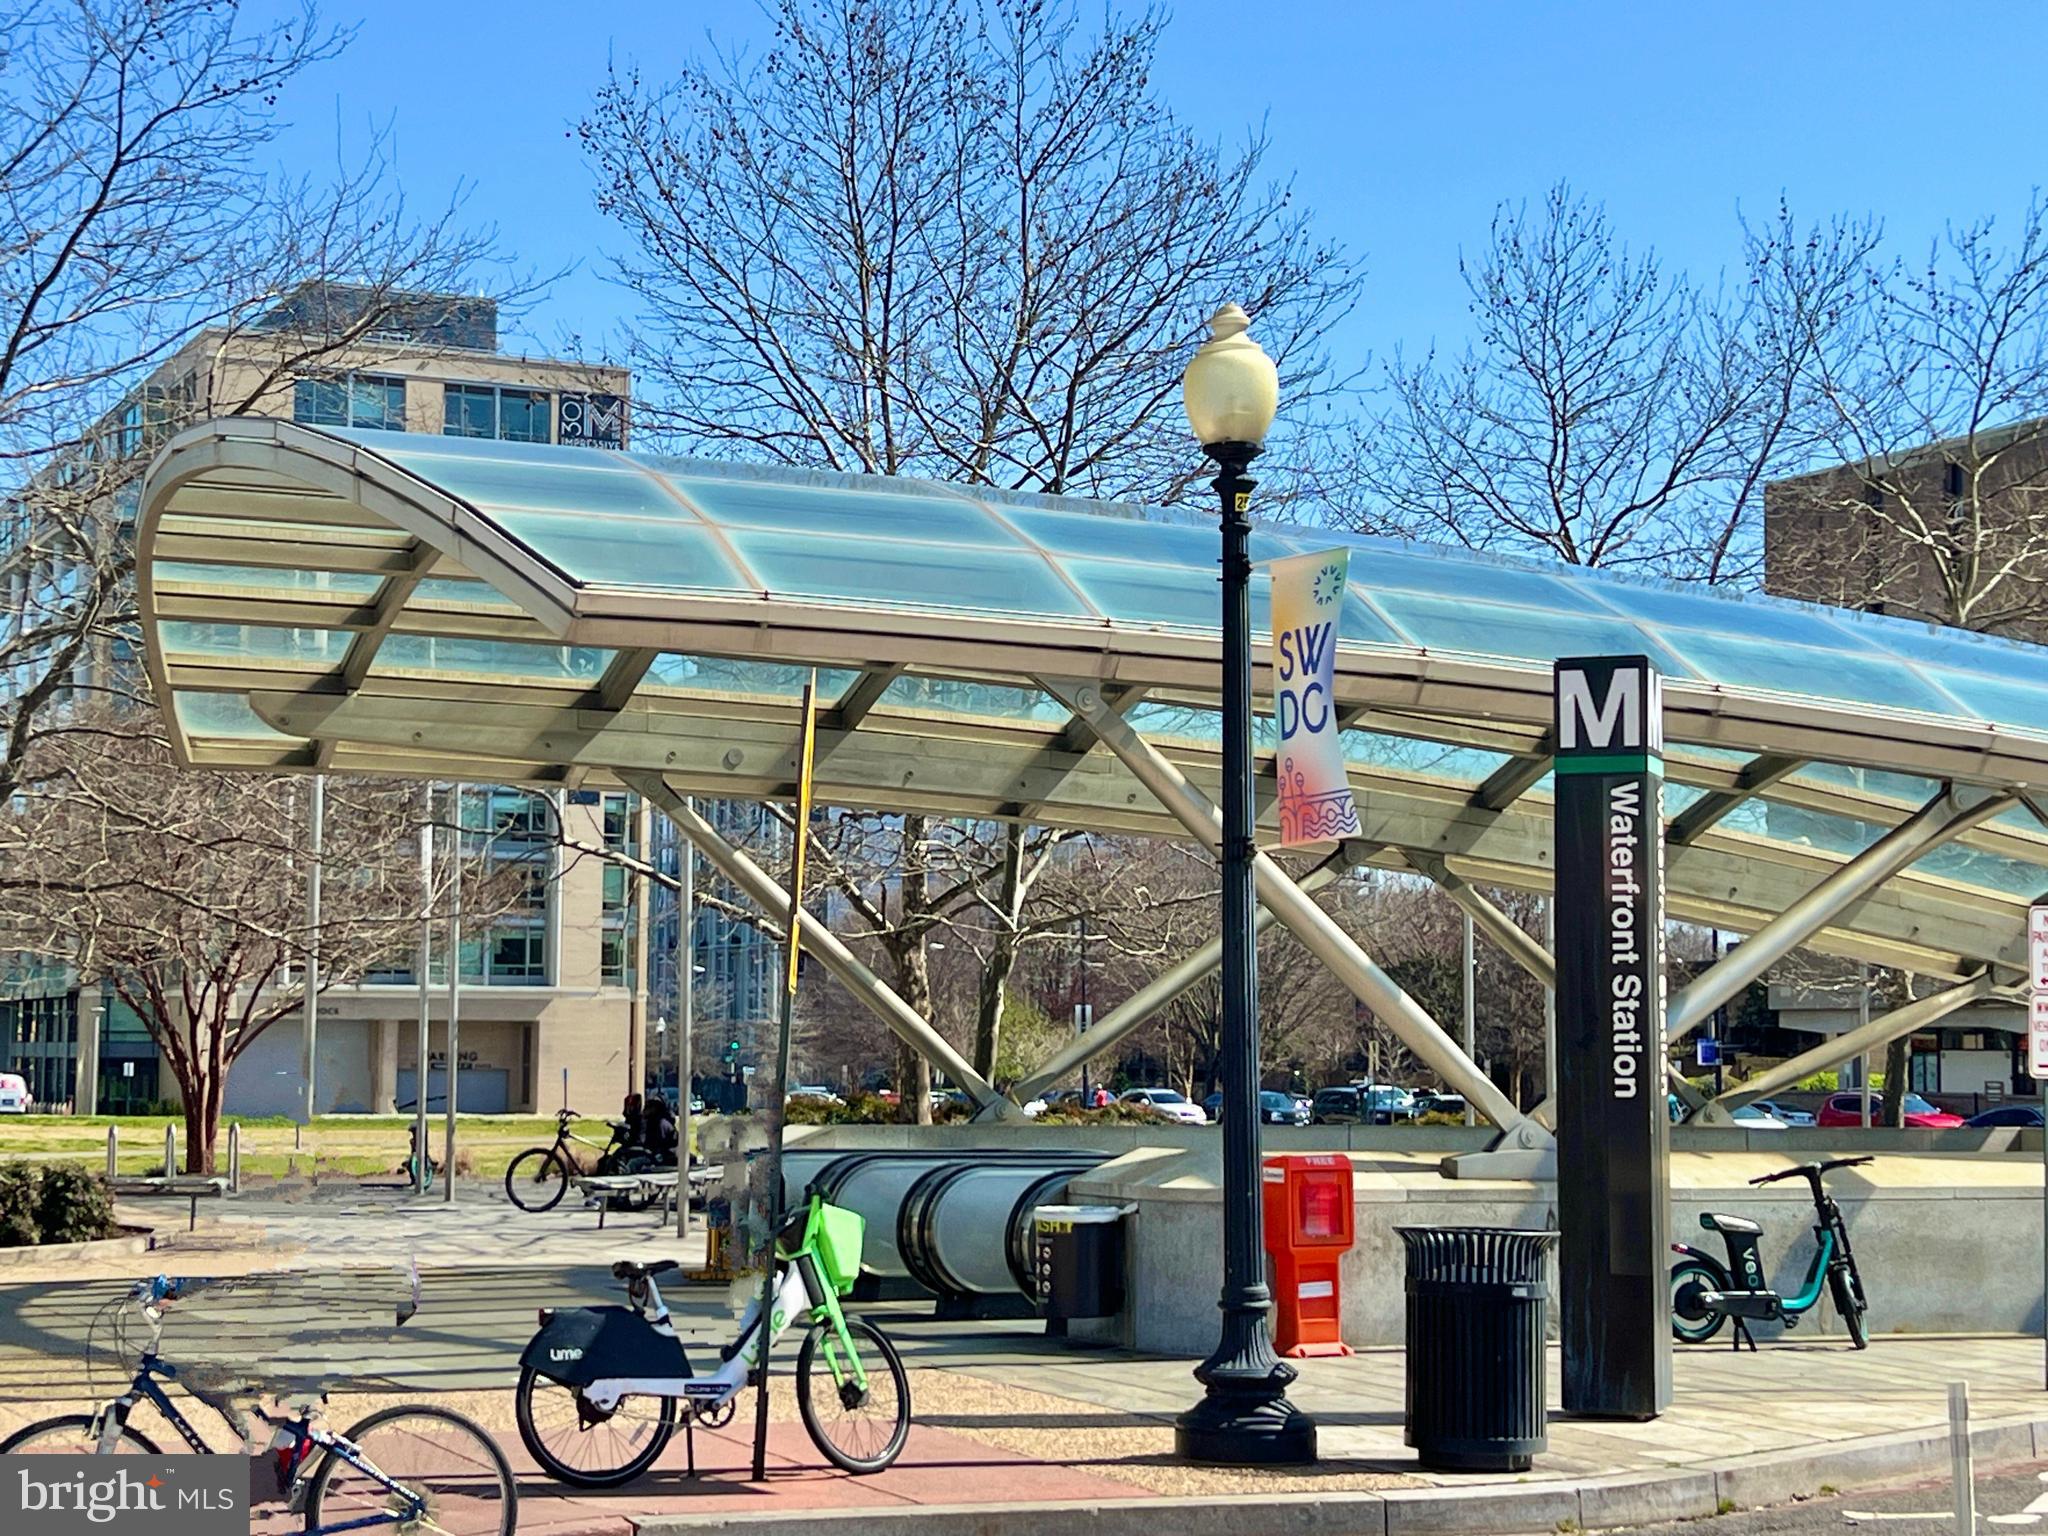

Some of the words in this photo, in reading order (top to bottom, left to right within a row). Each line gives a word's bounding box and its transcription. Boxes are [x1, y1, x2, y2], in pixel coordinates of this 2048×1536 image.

[561, 438, 621, 450] IMPRESSIVE
[1279, 621, 1332, 681] SW
[1280, 682, 1328, 740] DC
[1559, 668, 1640, 749] M
[1611, 782, 1640, 964] Waterfront
[1612, 974, 1643, 1098] Station
